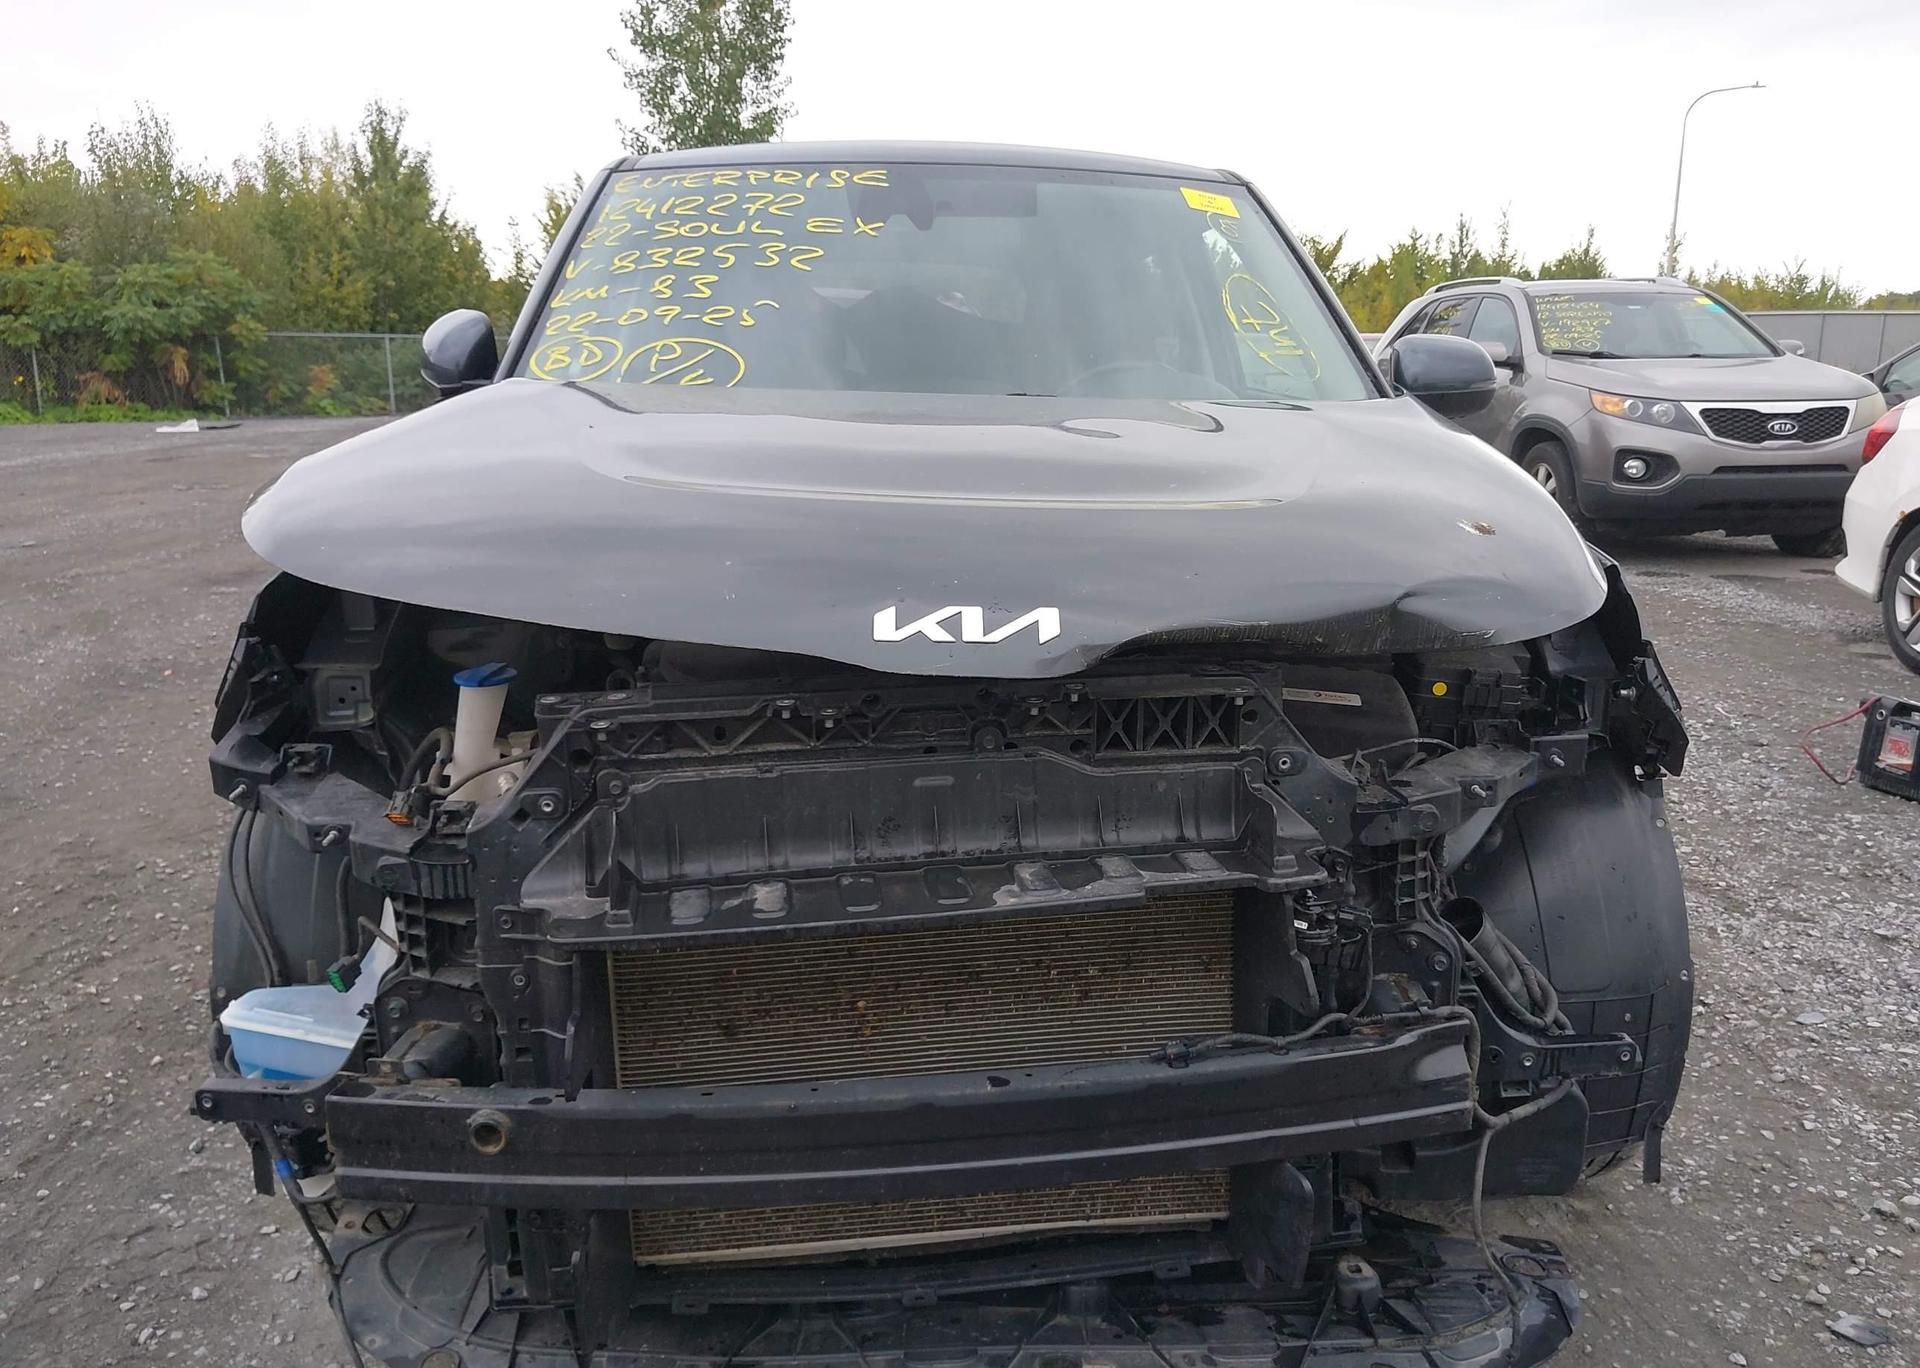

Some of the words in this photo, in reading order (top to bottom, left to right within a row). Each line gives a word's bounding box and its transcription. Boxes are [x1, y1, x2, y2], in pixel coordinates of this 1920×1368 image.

[601, 193, 805, 220] 12412272
[805, 216, 885, 238] EX
[565, 242, 824, 280] V-832532
[546, 300, 780, 336] 22-09-25
[544, 341, 603, 372] BD
[1773, 423, 1792, 431] KIA
[872, 605, 1061, 645] KIA
